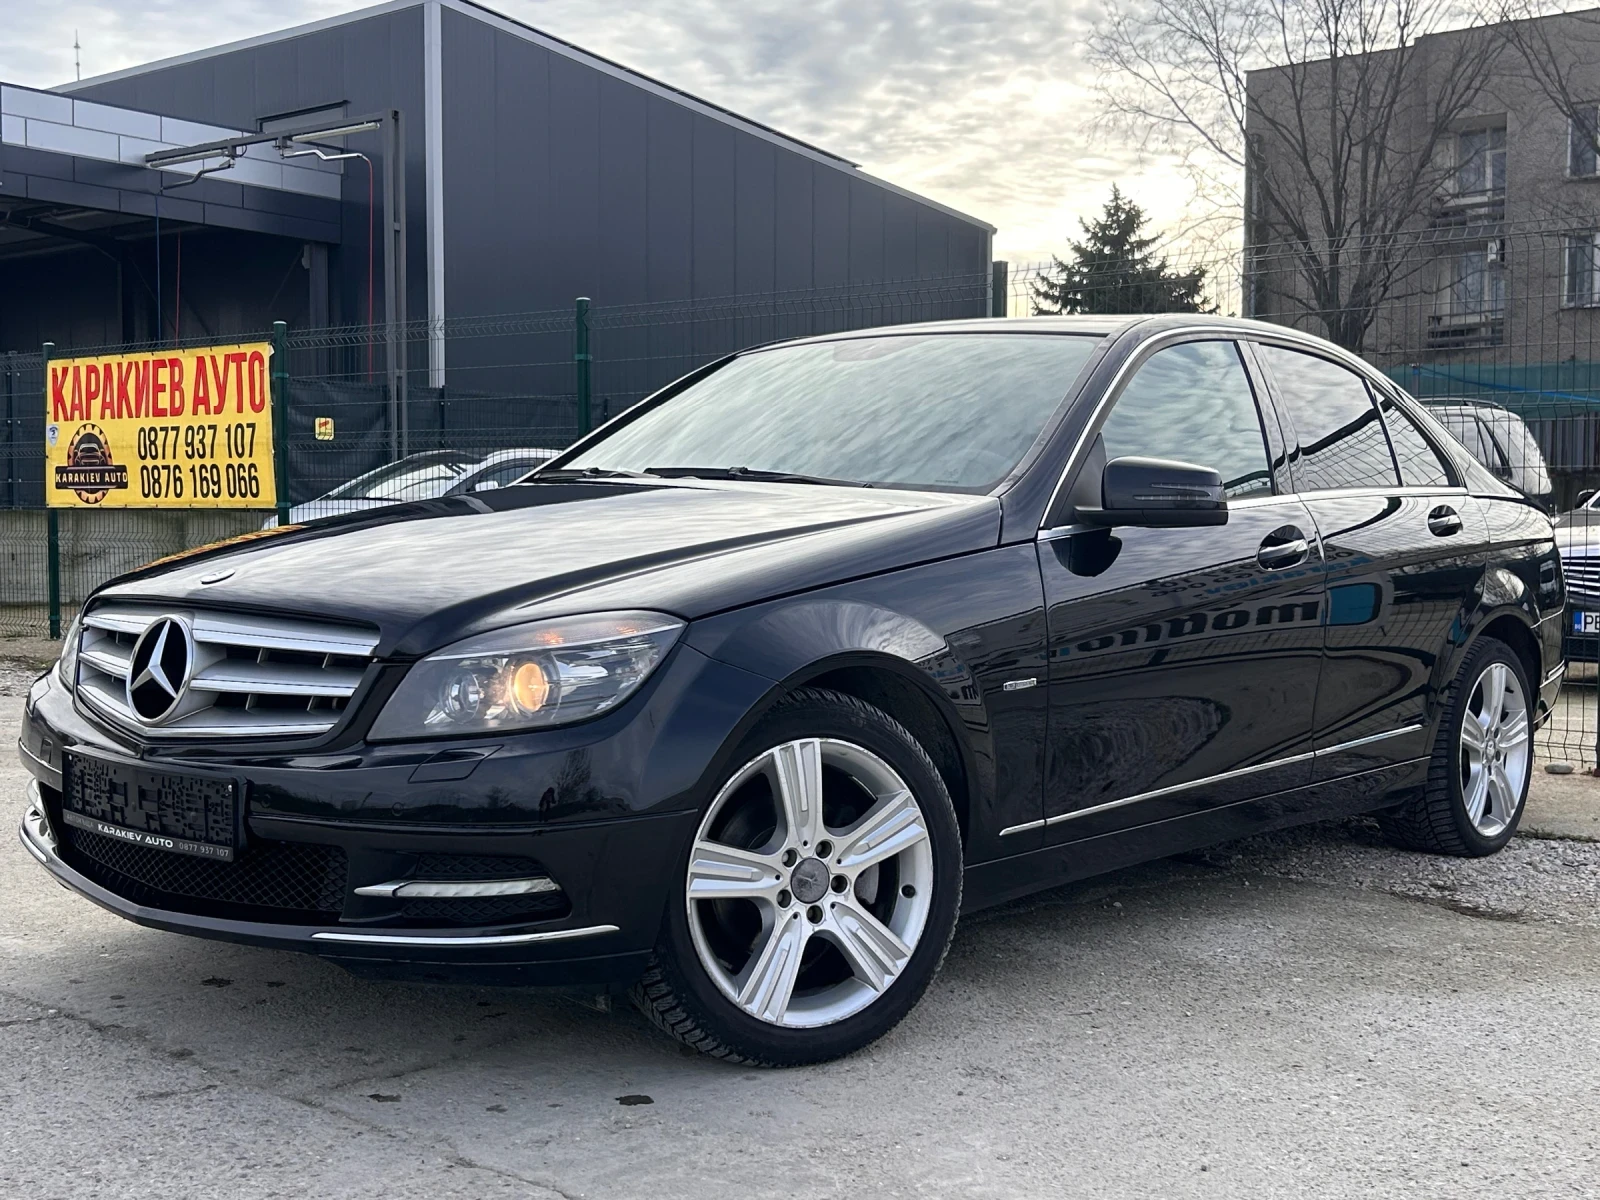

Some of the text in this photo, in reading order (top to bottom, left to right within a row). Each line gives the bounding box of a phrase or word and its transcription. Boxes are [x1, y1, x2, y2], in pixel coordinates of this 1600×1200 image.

[51, 350, 266, 422] КАРАКИЕВ АУТО
[137, 422, 257, 461] 0877 937 107
[55, 471, 128, 483] KARAKIEV AUTO
[140, 463, 260, 499] 0876 169 066
[97, 823, 174, 848] KARAKIEV AUTO
[178, 842, 229, 858] 0877 937 107
